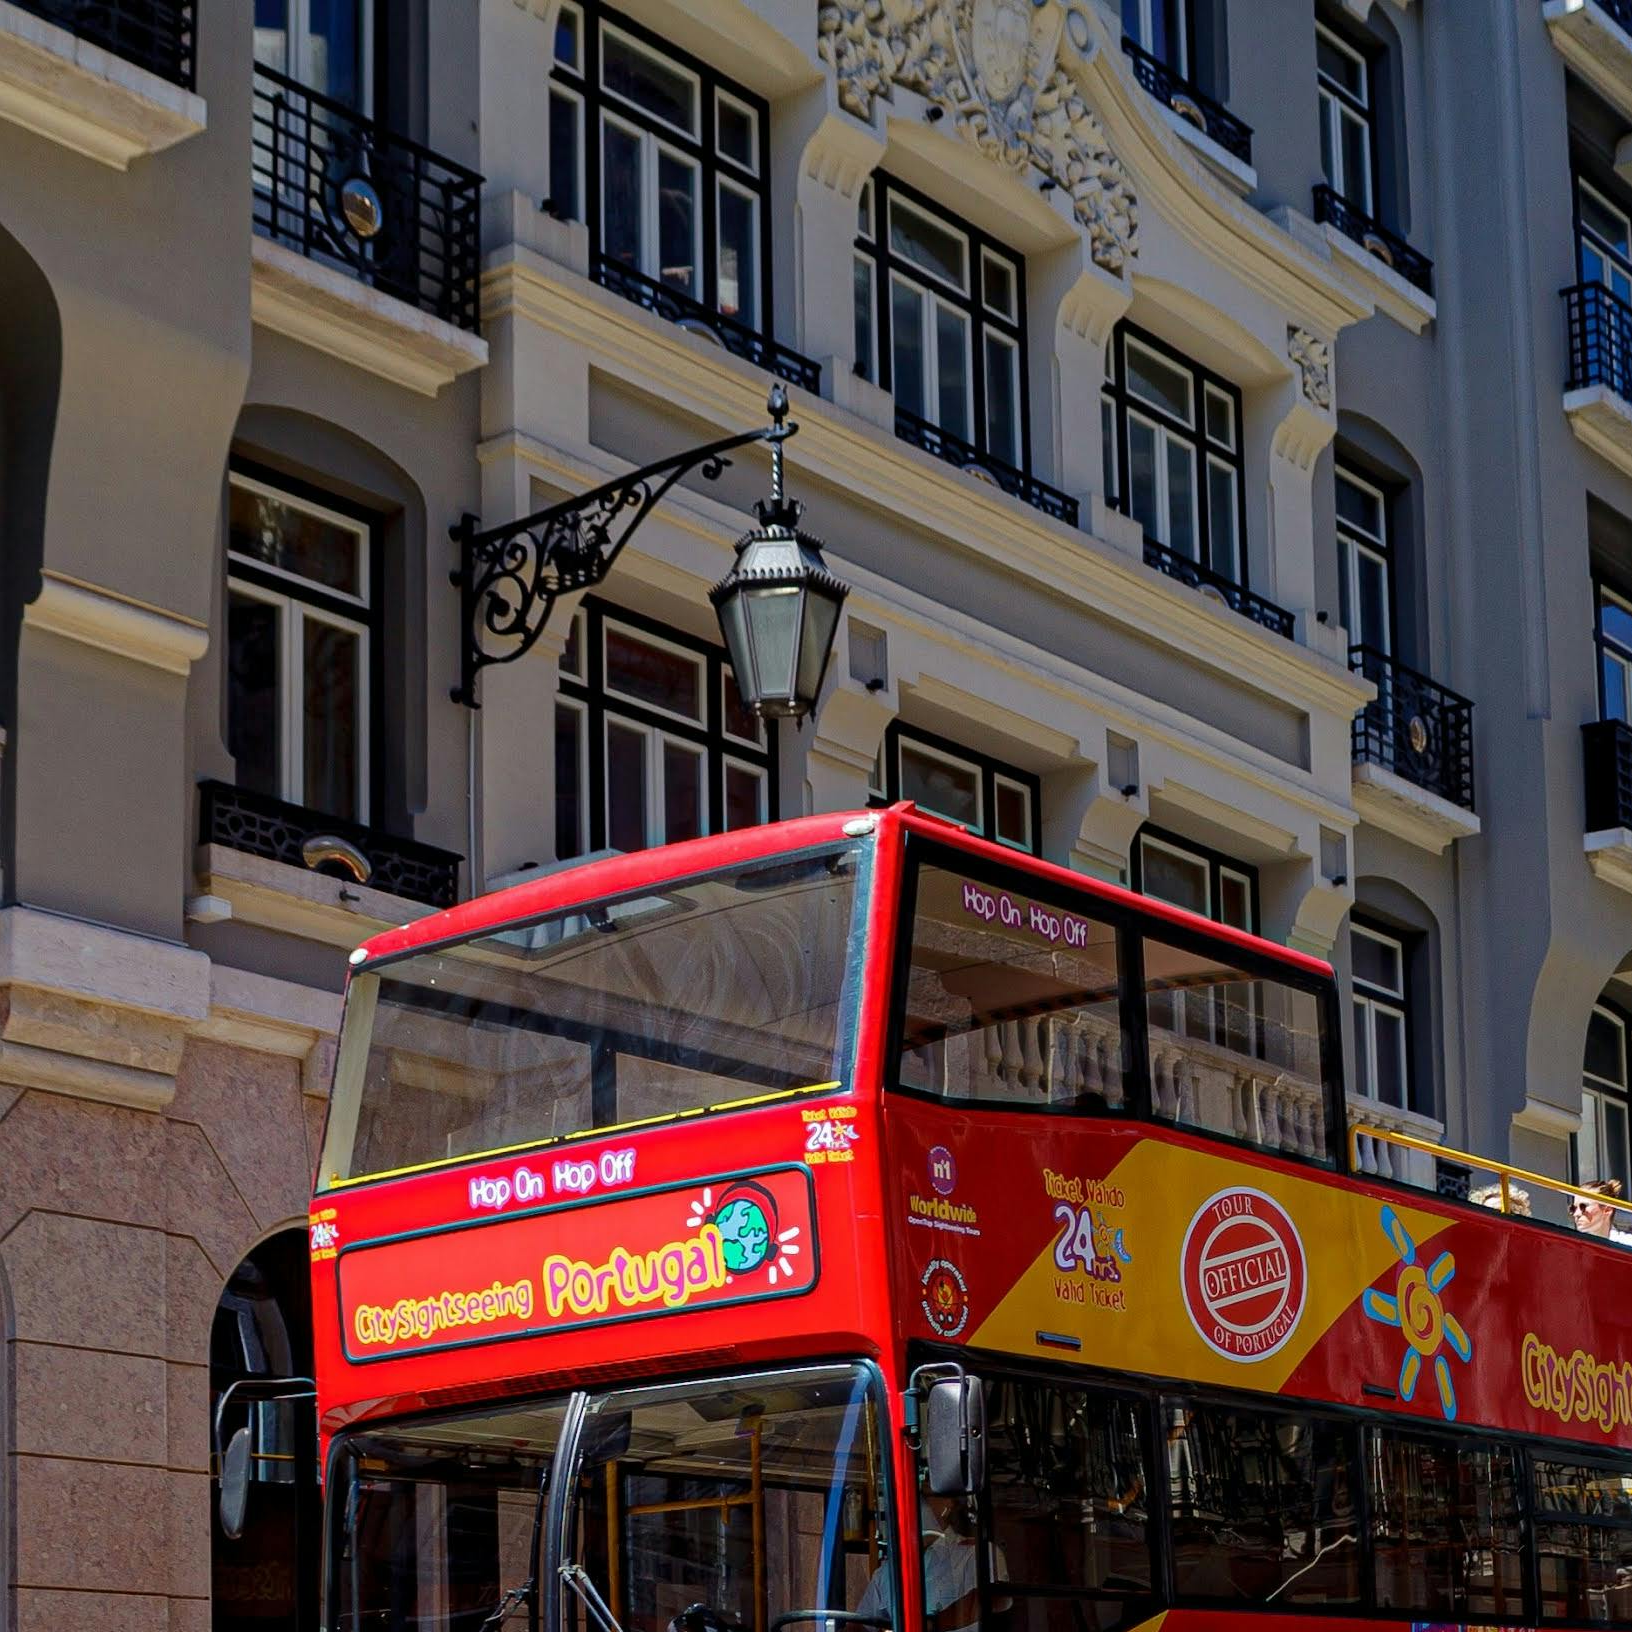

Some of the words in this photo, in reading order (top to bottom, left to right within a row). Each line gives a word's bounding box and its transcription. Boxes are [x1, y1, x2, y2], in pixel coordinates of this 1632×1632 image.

[962, 883, 997, 921] Hop
[999, 894, 1022, 928] On
[1028, 905, 1062, 942] Hop
[1062, 915, 1088, 948] Off
[468, 1176, 513, 1209] Hop
[514, 1167, 545, 1202] On
[552, 1160, 597, 1194] Hop
[599, 1148, 636, 1186] Off
[910, 1195, 977, 1223] Worldwide
[1212, 1195, 1254, 1223] TOUR
[1053, 1202, 1096, 1274] 24
[356, 1279, 532, 1344] CitySightseeing
[543, 1223, 725, 1317] Portugal
[1204, 1251, 1286, 1299] OFFICIAL
[1213, 1325, 1232, 1349] OF
[1235, 1304, 1296, 1354] PORTUGAL
